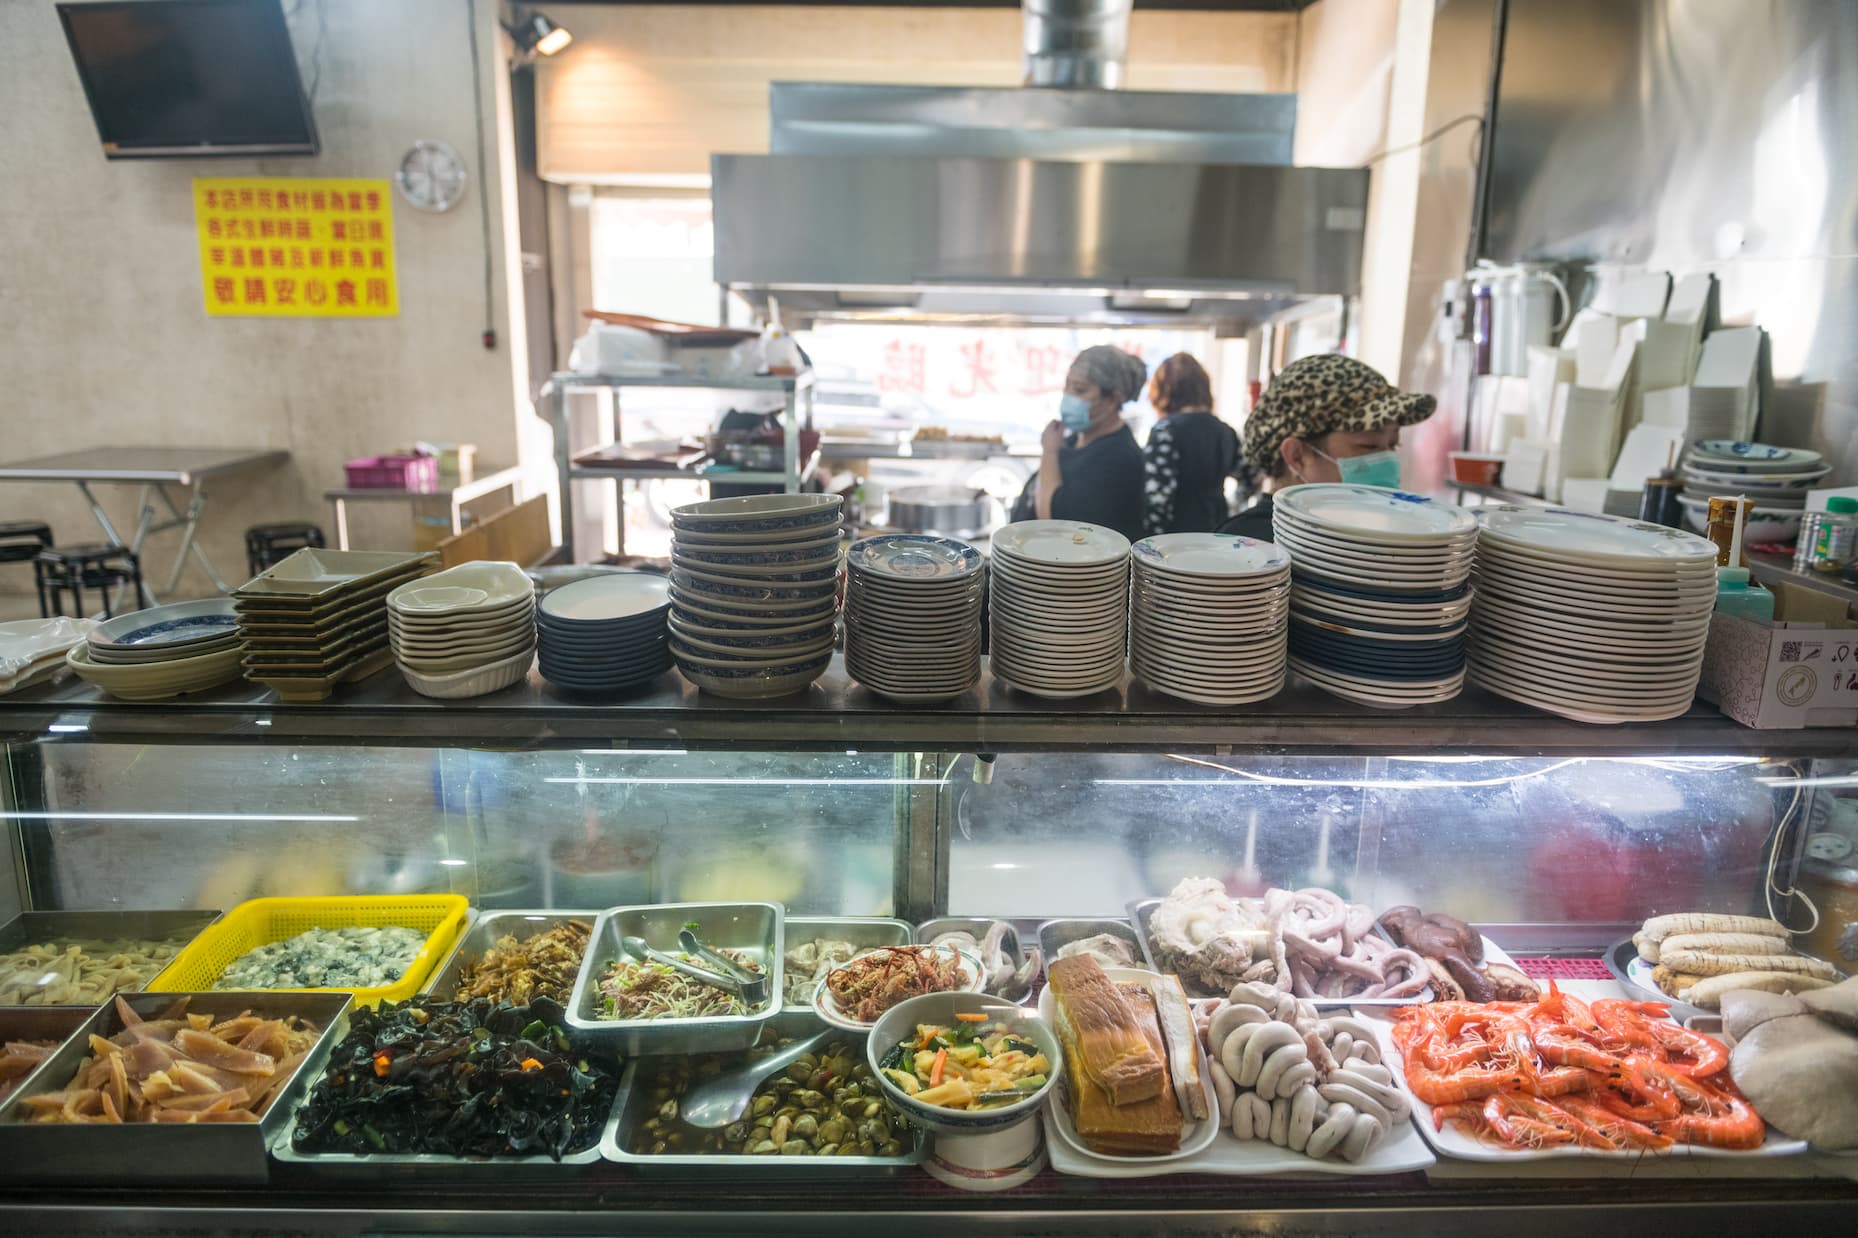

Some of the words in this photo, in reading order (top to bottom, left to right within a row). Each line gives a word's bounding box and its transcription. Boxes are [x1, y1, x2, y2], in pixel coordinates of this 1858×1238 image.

[214, 277, 388, 305] 敬請安心食用
